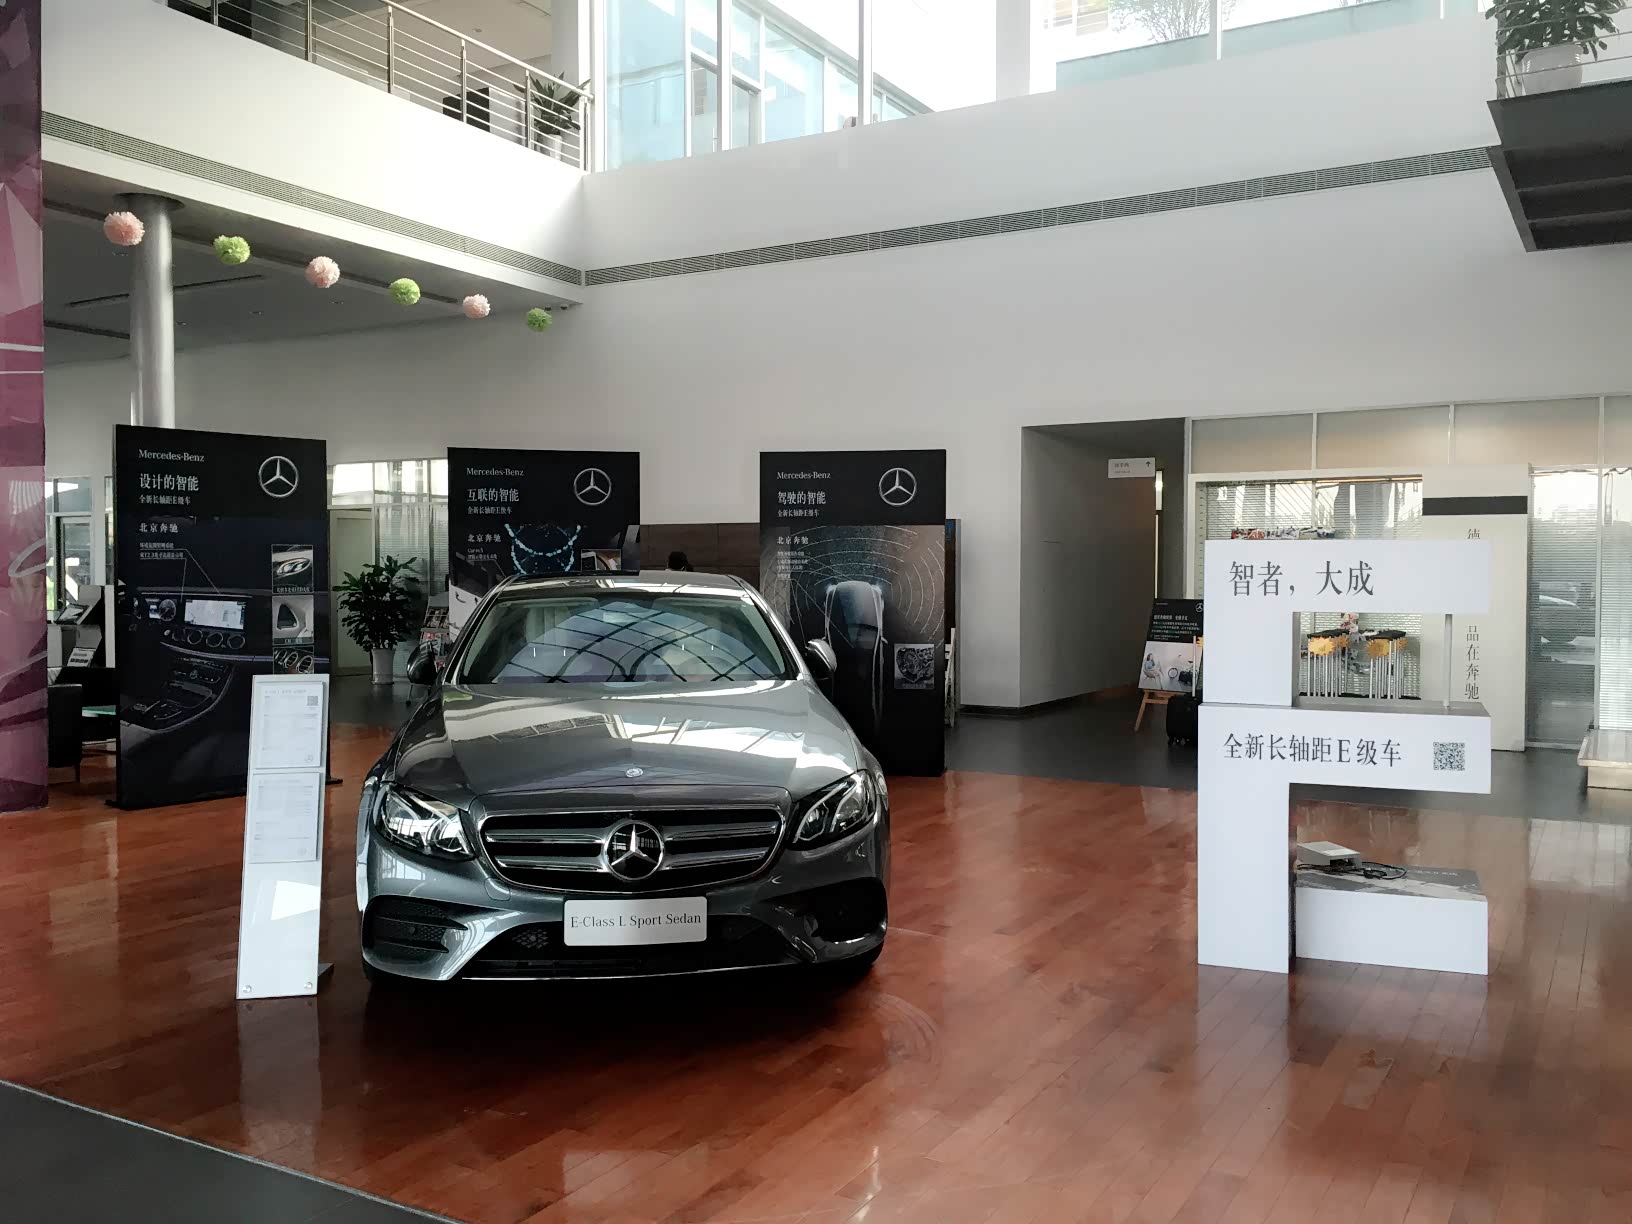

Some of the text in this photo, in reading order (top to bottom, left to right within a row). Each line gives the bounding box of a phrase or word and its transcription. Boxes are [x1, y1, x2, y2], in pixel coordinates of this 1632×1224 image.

[138, 448, 205, 463] Mercedes-Benz
[466, 467, 524, 477] Mercedes-Benz
[776, 471, 831, 480] Mercedes-Benz
[139, 473, 200, 492] 设计的智能
[467, 488, 520, 503] 互联的智能
[777, 490, 827, 506] 驾驶的智能
[139, 522, 179, 534] 北京奔驰
[467, 533, 502, 543] 北京奔驰
[776, 535, 809, 546] 北京奔驰
[1464, 625, 1480, 700] 品在奔驰
[1223, 732, 1402, 768] 全新长轴距E级车
[570, 912, 702, 929] E-Class L Sport Sedan
